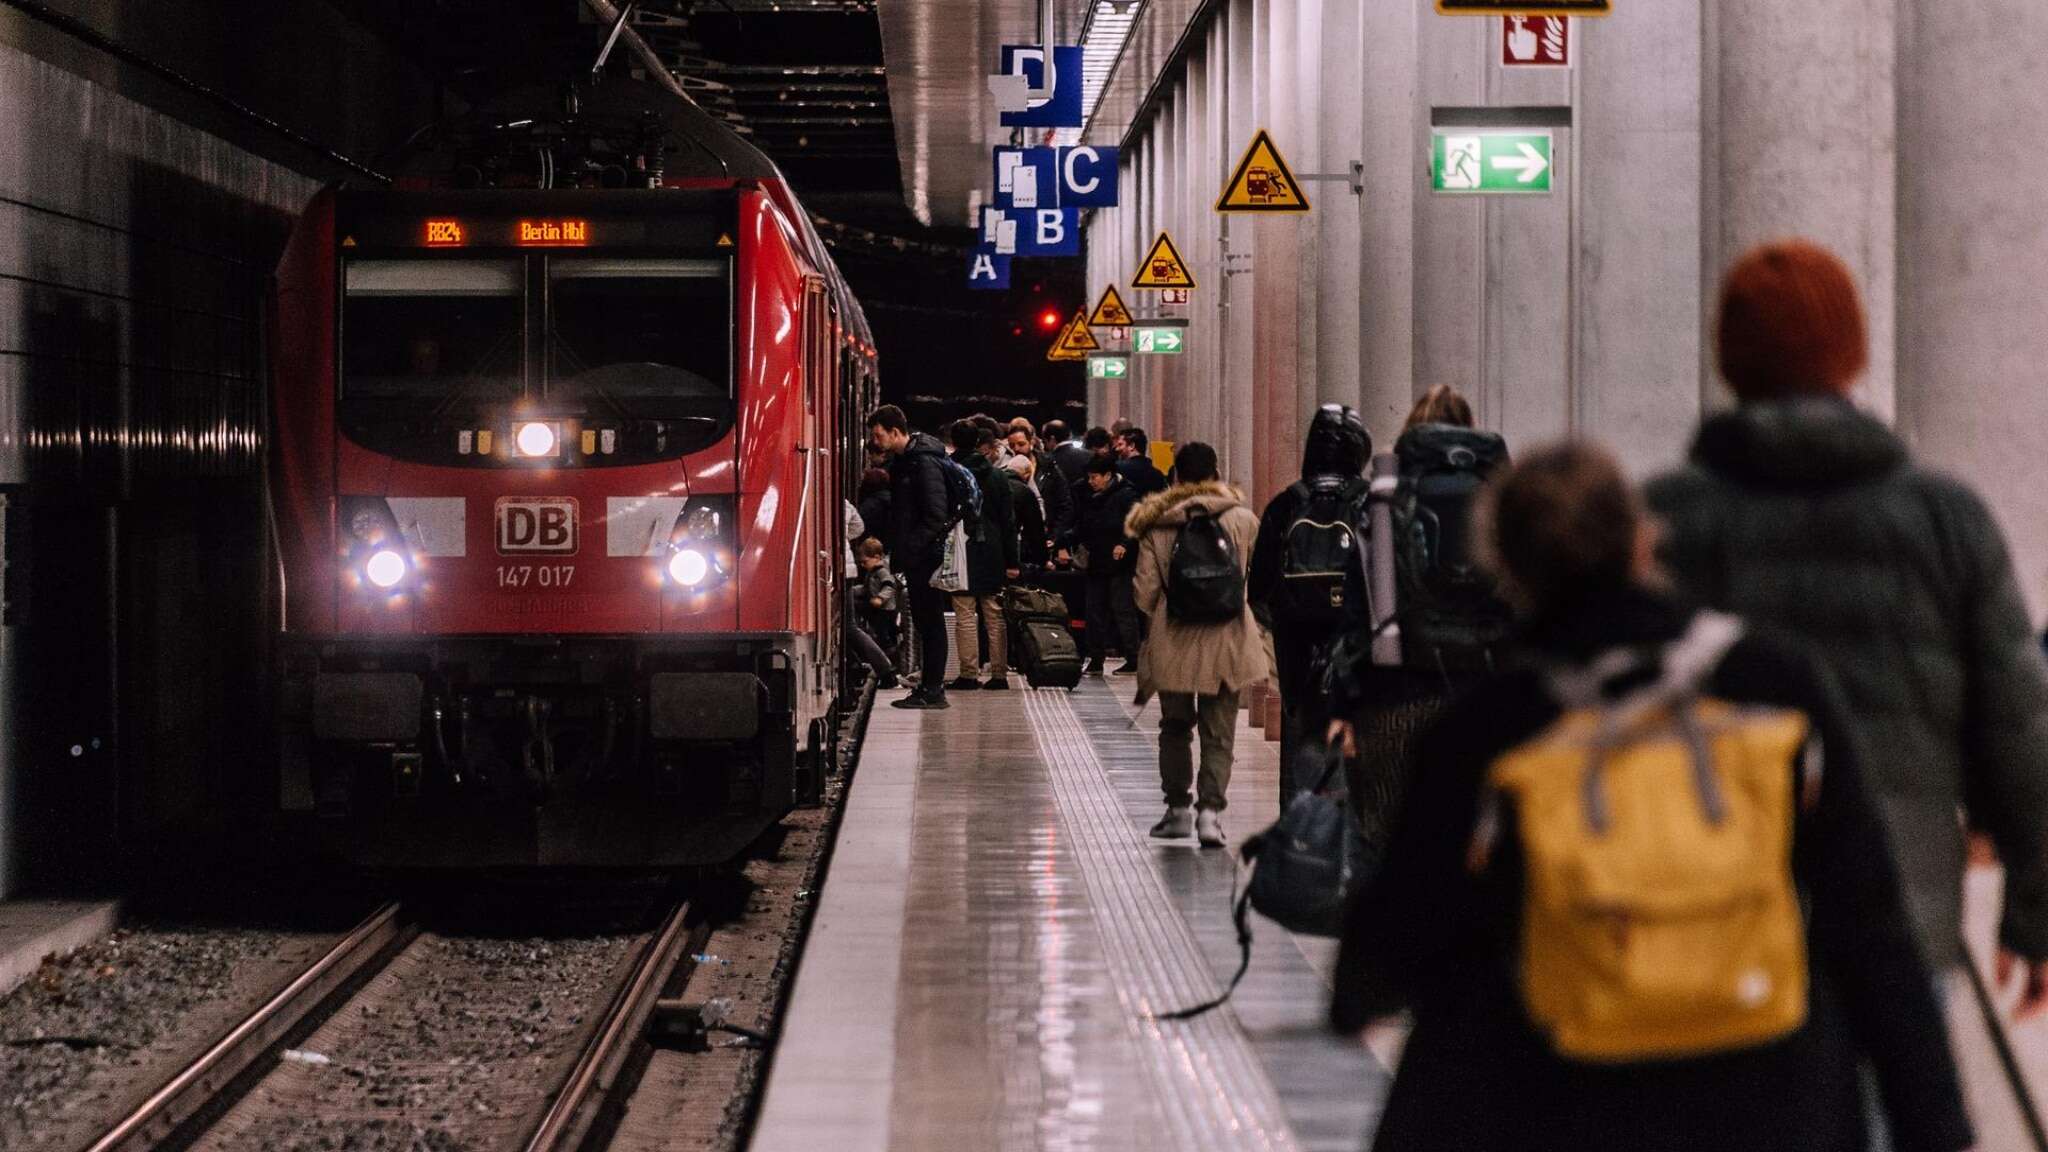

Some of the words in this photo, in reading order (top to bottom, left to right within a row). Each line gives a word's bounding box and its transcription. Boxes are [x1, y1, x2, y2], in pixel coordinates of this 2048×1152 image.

[1013, 49, 1057, 108] D
[1064, 147, 1100, 194] C
[427, 221, 461, 241] RB24
[521, 222, 560, 241] Berlin
[562, 221, 585, 240] Hbf
[1036, 209, 1064, 244] B
[970, 254, 997, 280] A
[506, 506, 569, 546] DB
[496, 565, 532, 587] 147
[538, 565, 575, 587] 017
